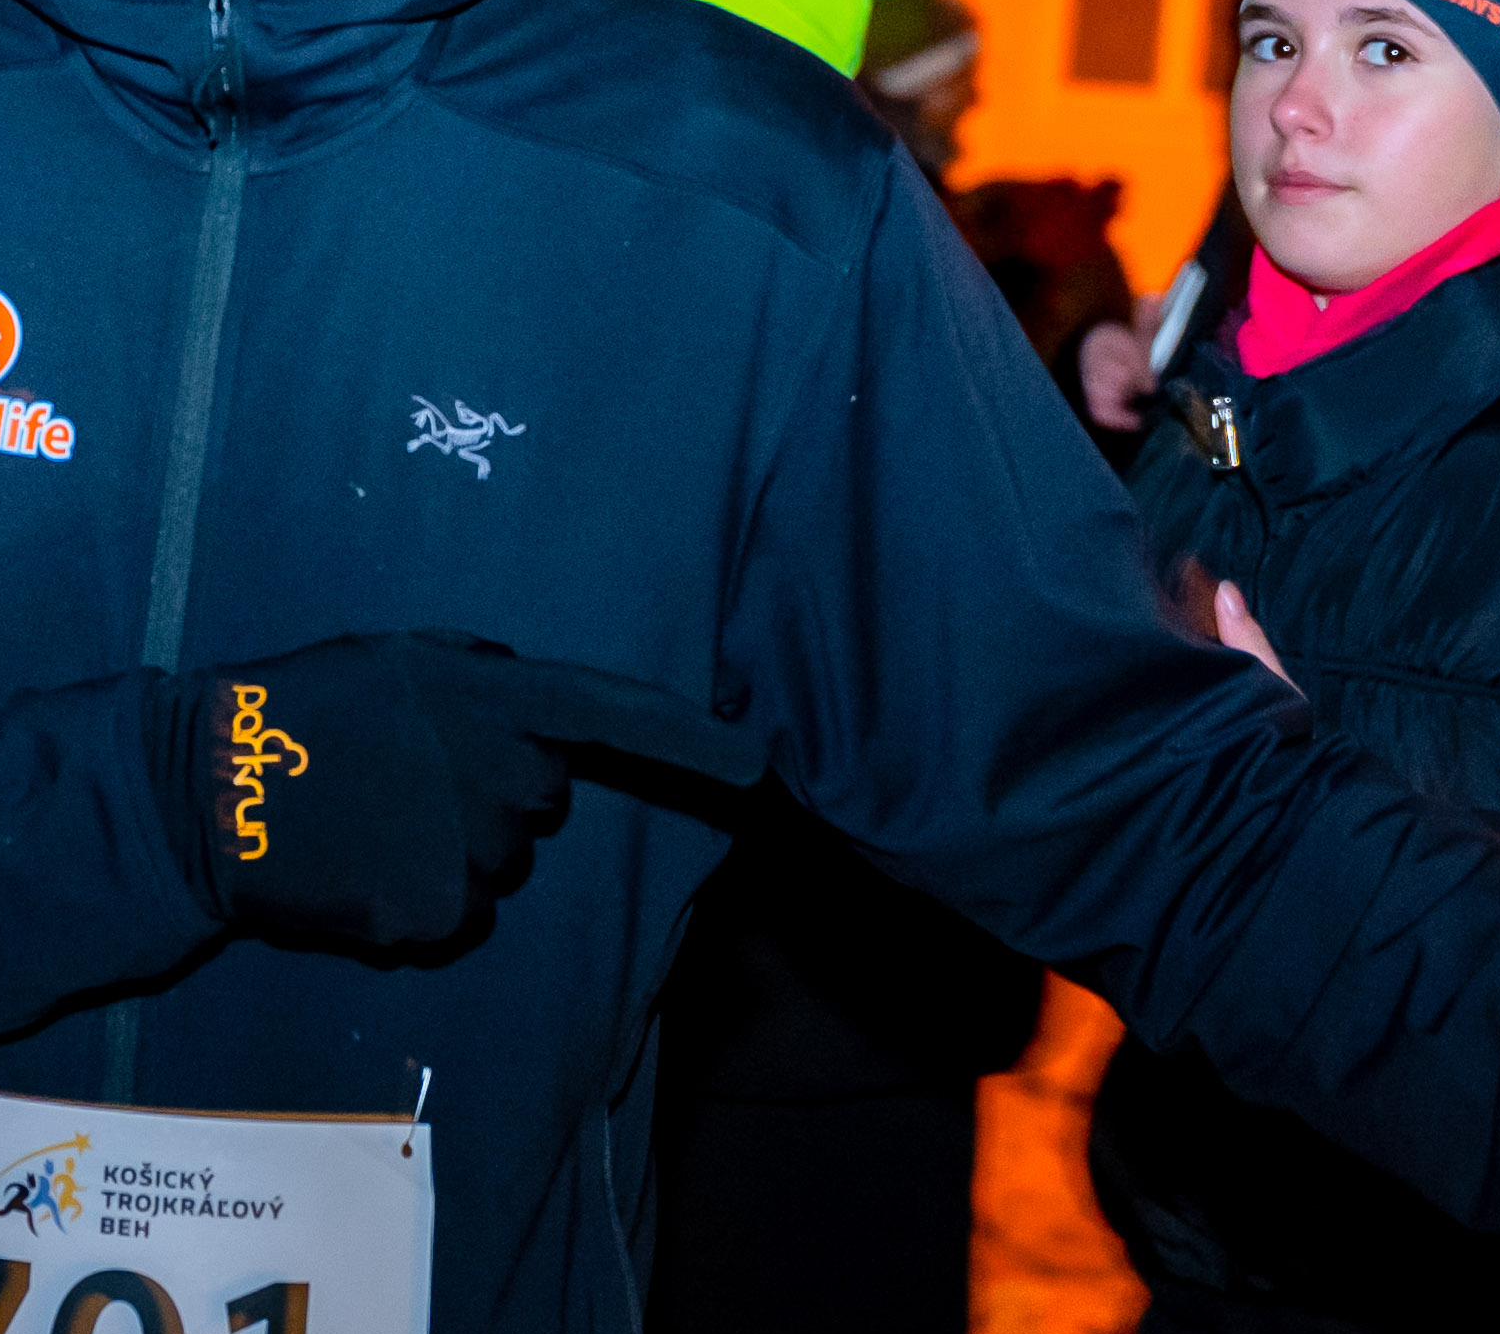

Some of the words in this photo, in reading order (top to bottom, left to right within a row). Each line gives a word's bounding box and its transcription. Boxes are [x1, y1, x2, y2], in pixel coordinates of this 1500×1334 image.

[232, 684, 308, 860] parkrun
[103, 1162, 215, 1191] KOŠICKÝ
[101, 1192, 284, 1219] TROJKRÁĽOVÝ
[100, 1217, 150, 1238] BEH
